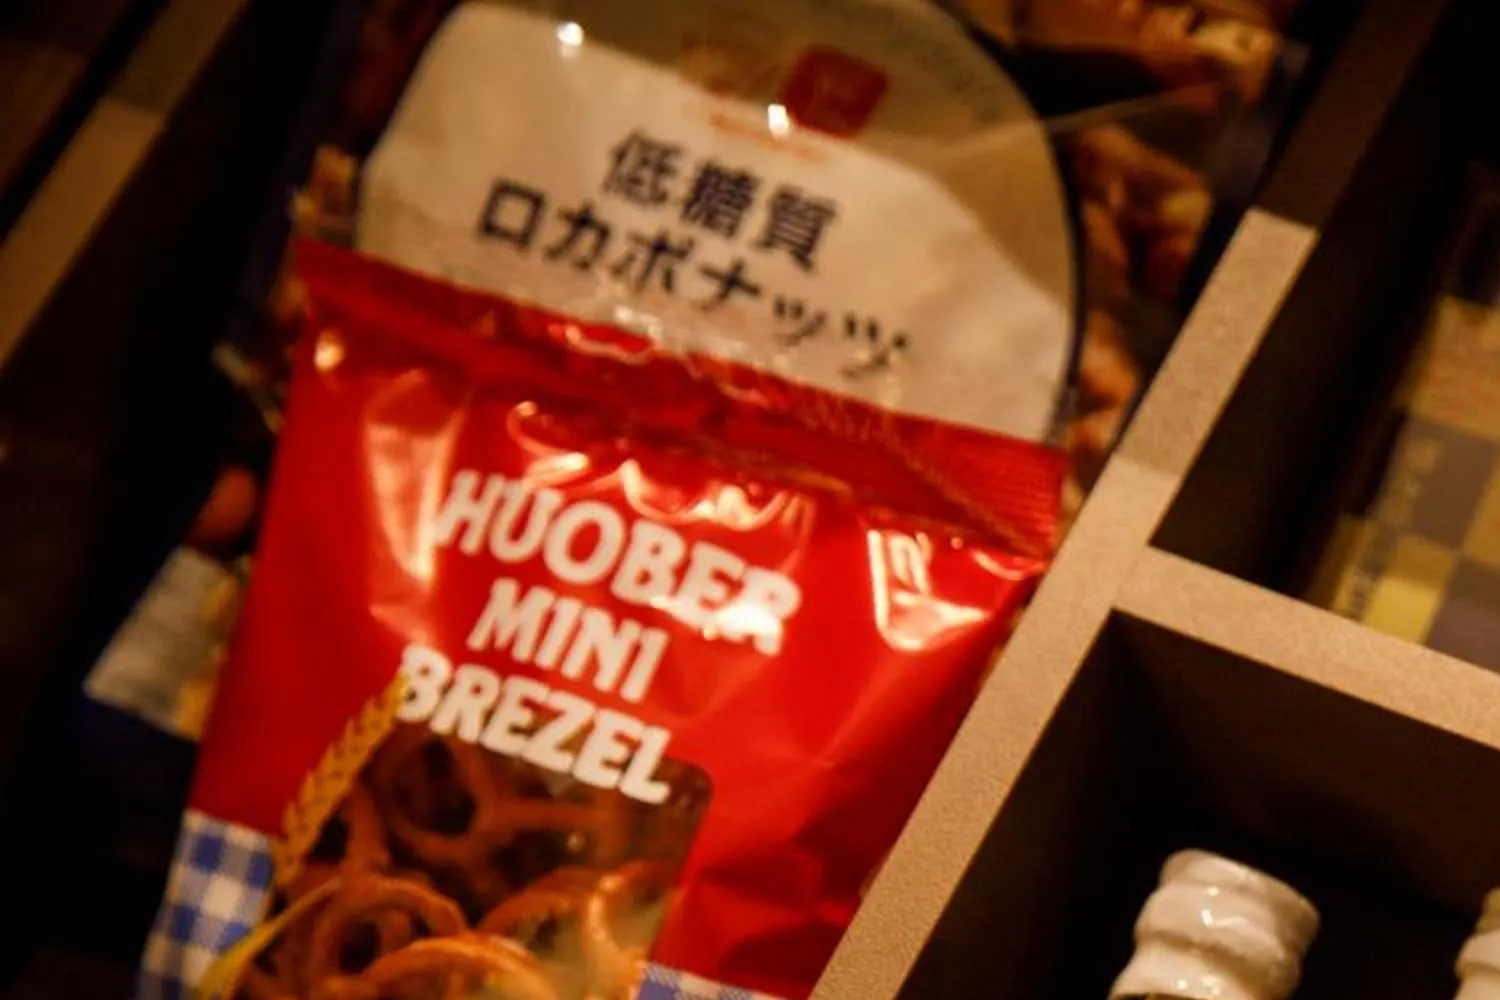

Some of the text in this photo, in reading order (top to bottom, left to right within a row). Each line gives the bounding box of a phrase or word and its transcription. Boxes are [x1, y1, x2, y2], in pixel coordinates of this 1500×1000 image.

[477, 178, 908, 380] ロカボナッツ
[599, 128, 839, 274] 低糖質
[433, 469, 801, 656] HUOBER
[466, 576, 670, 703] MINI
[395, 645, 673, 803] BREZEL
